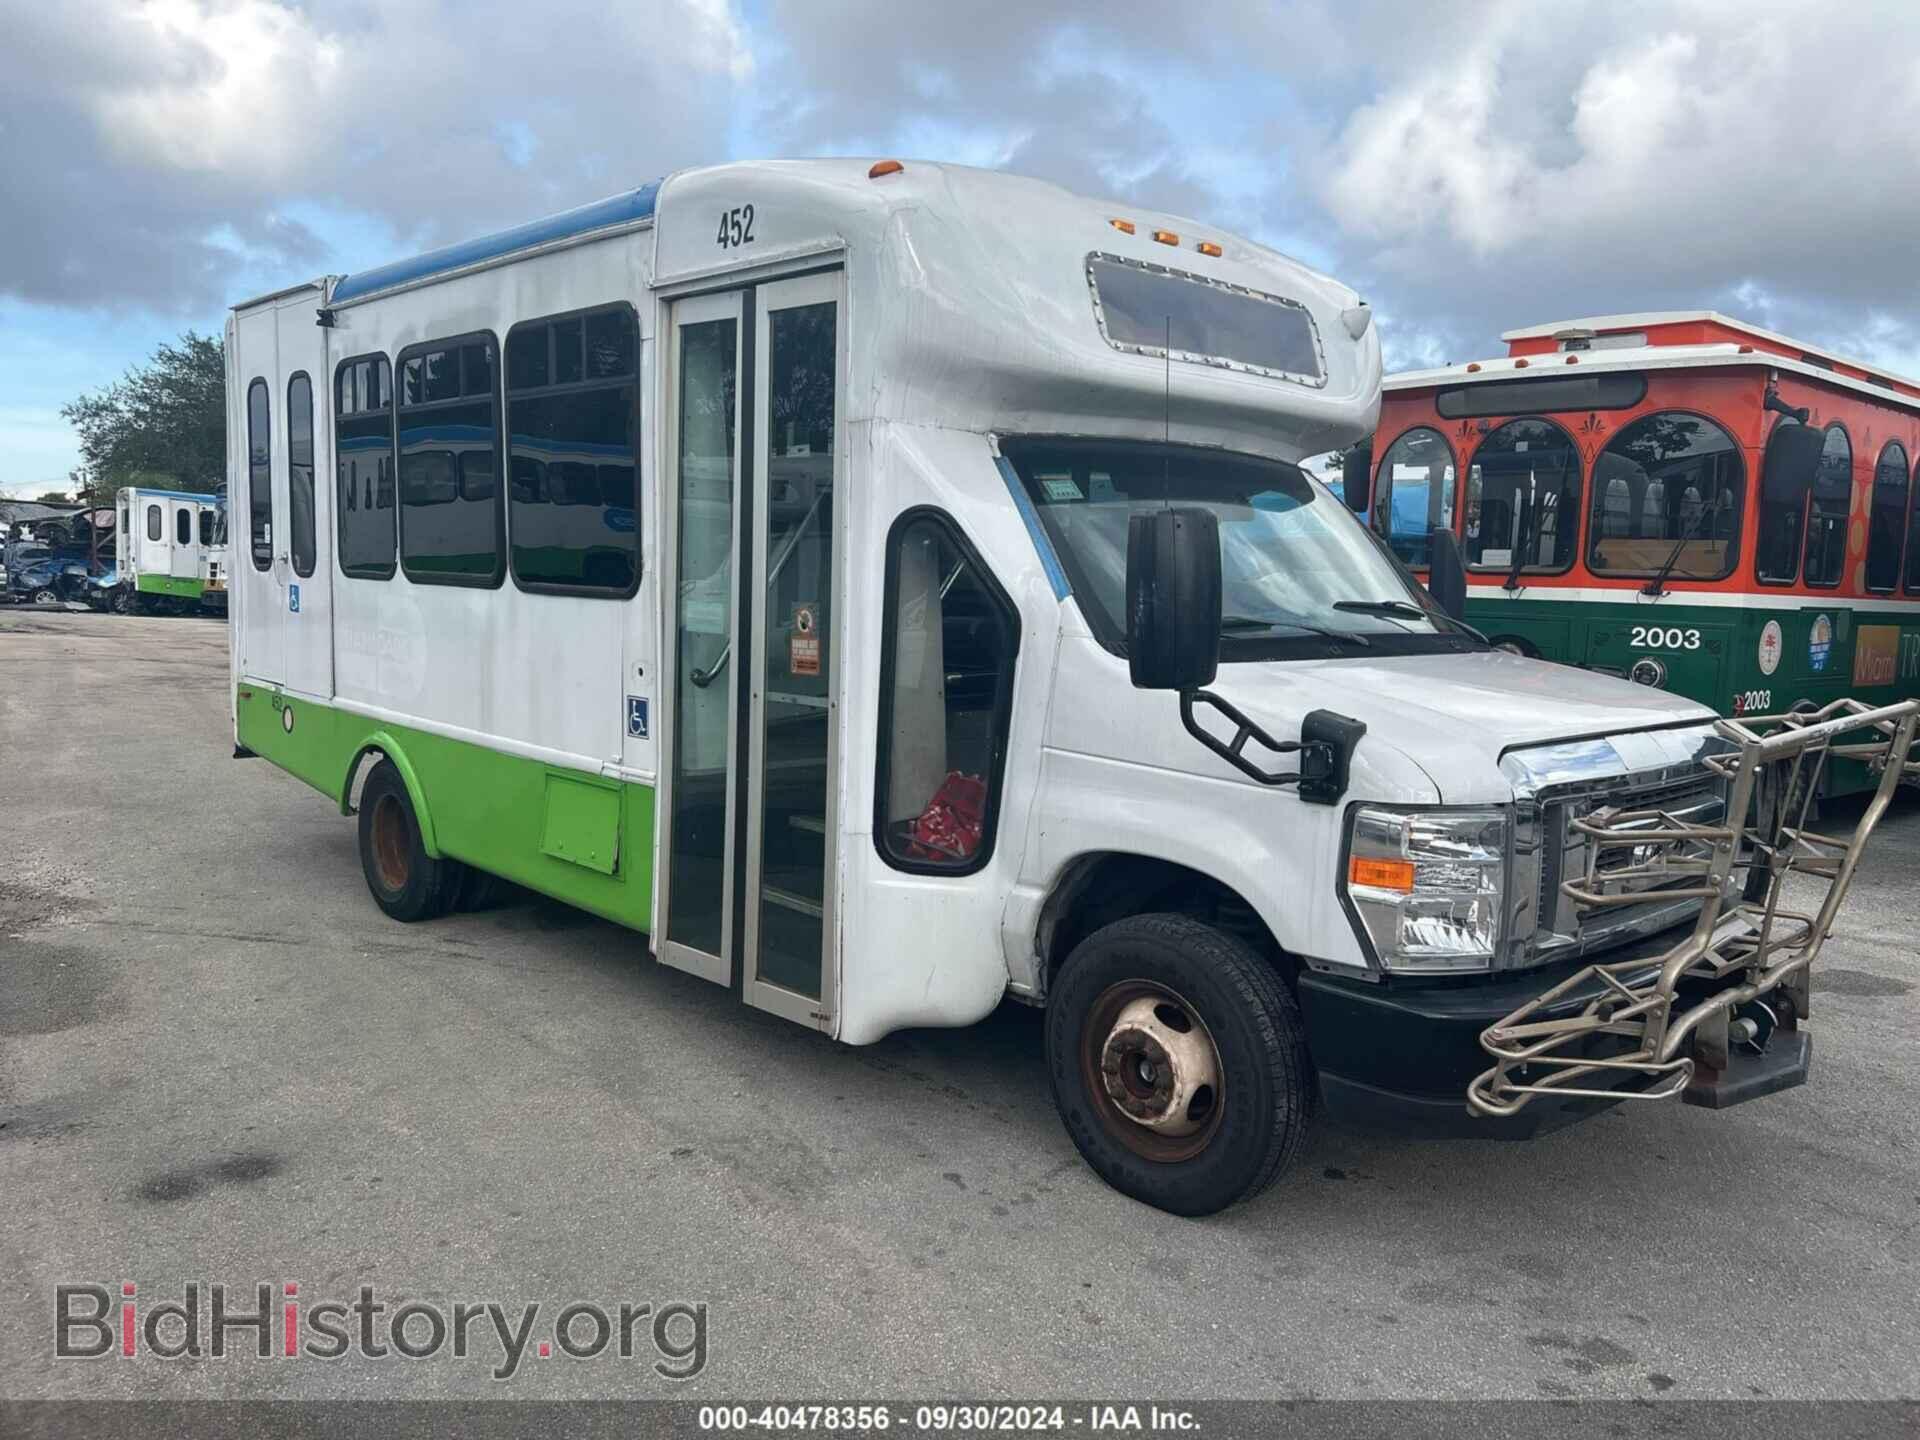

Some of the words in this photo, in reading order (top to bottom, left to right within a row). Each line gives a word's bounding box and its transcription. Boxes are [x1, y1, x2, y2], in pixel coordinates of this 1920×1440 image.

[717, 203, 755, 249] 452
[1630, 626, 1701, 650] 2003
[1744, 689, 1771, 711] 2003
